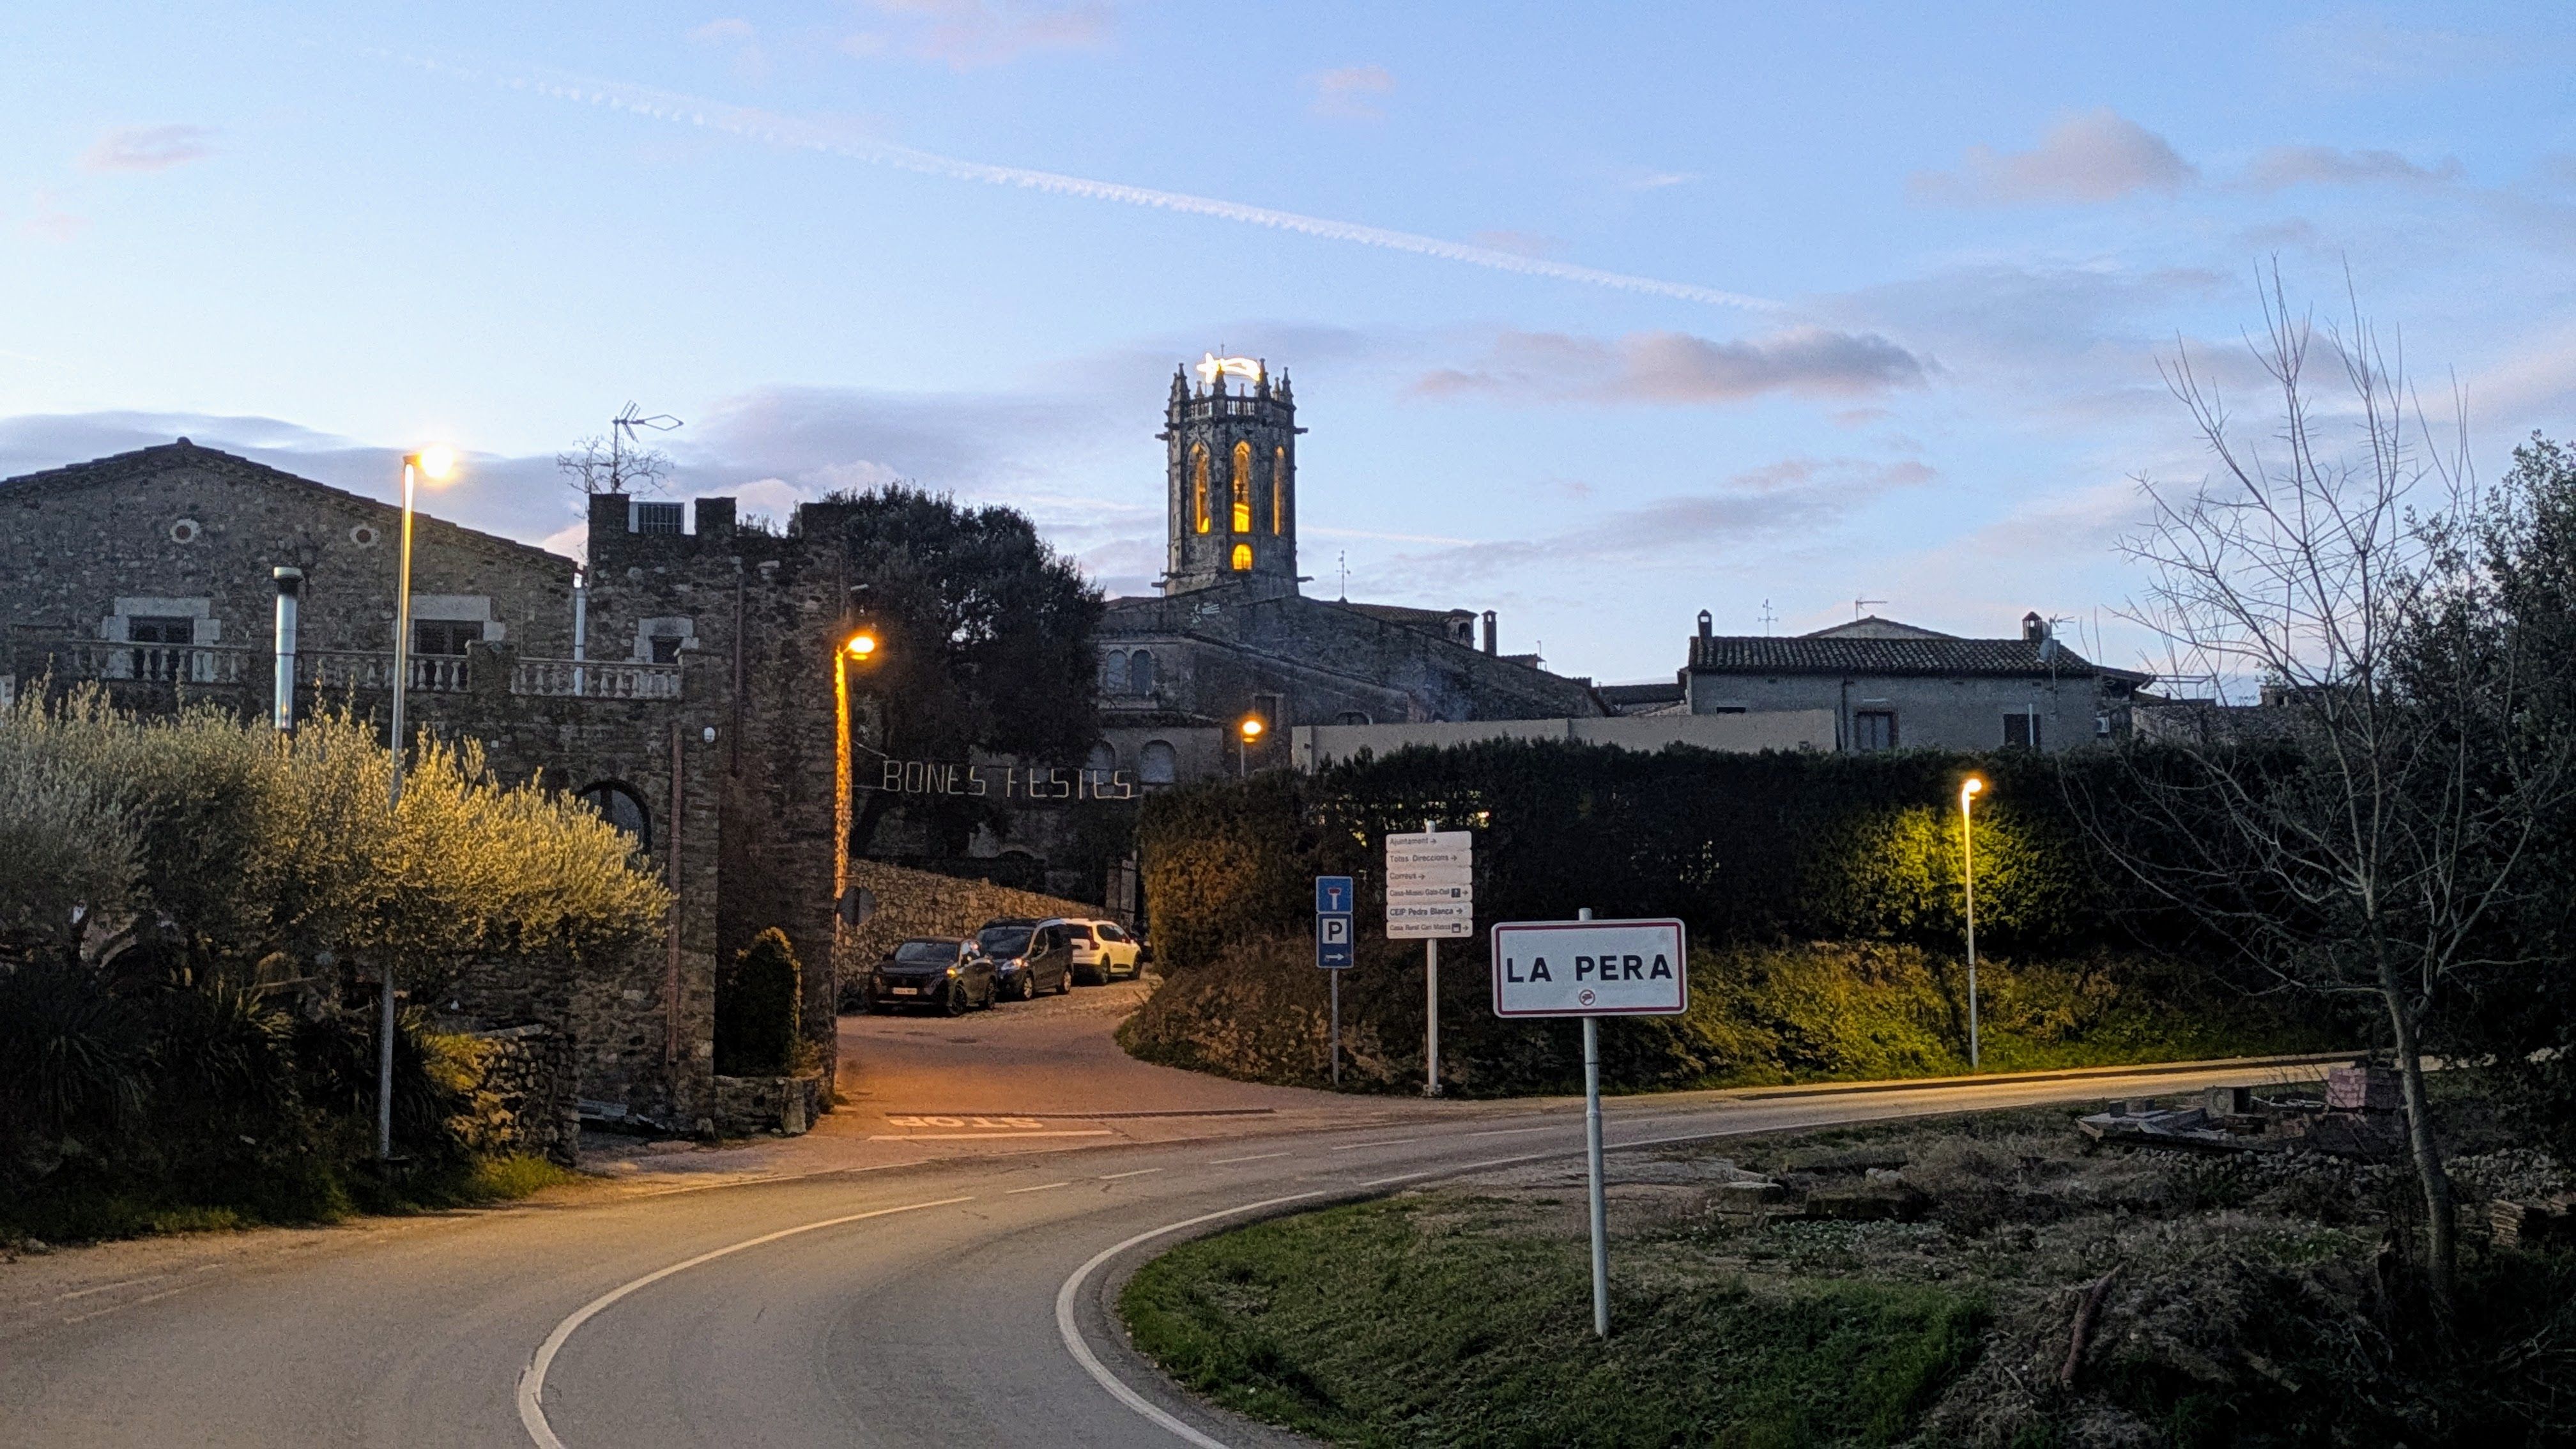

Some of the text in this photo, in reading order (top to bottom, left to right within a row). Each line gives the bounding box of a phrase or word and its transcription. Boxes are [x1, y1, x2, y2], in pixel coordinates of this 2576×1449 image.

[882, 760, 986, 797] BONES
[1389, 838, 1429, 846] Ajuntament
[1390, 908, 1406, 916] CEIP
[1408, 907, 1428, 916] Pedra
[1328, 921, 1343, 941] P
[1506, 954, 1673, 983] LA PERA
